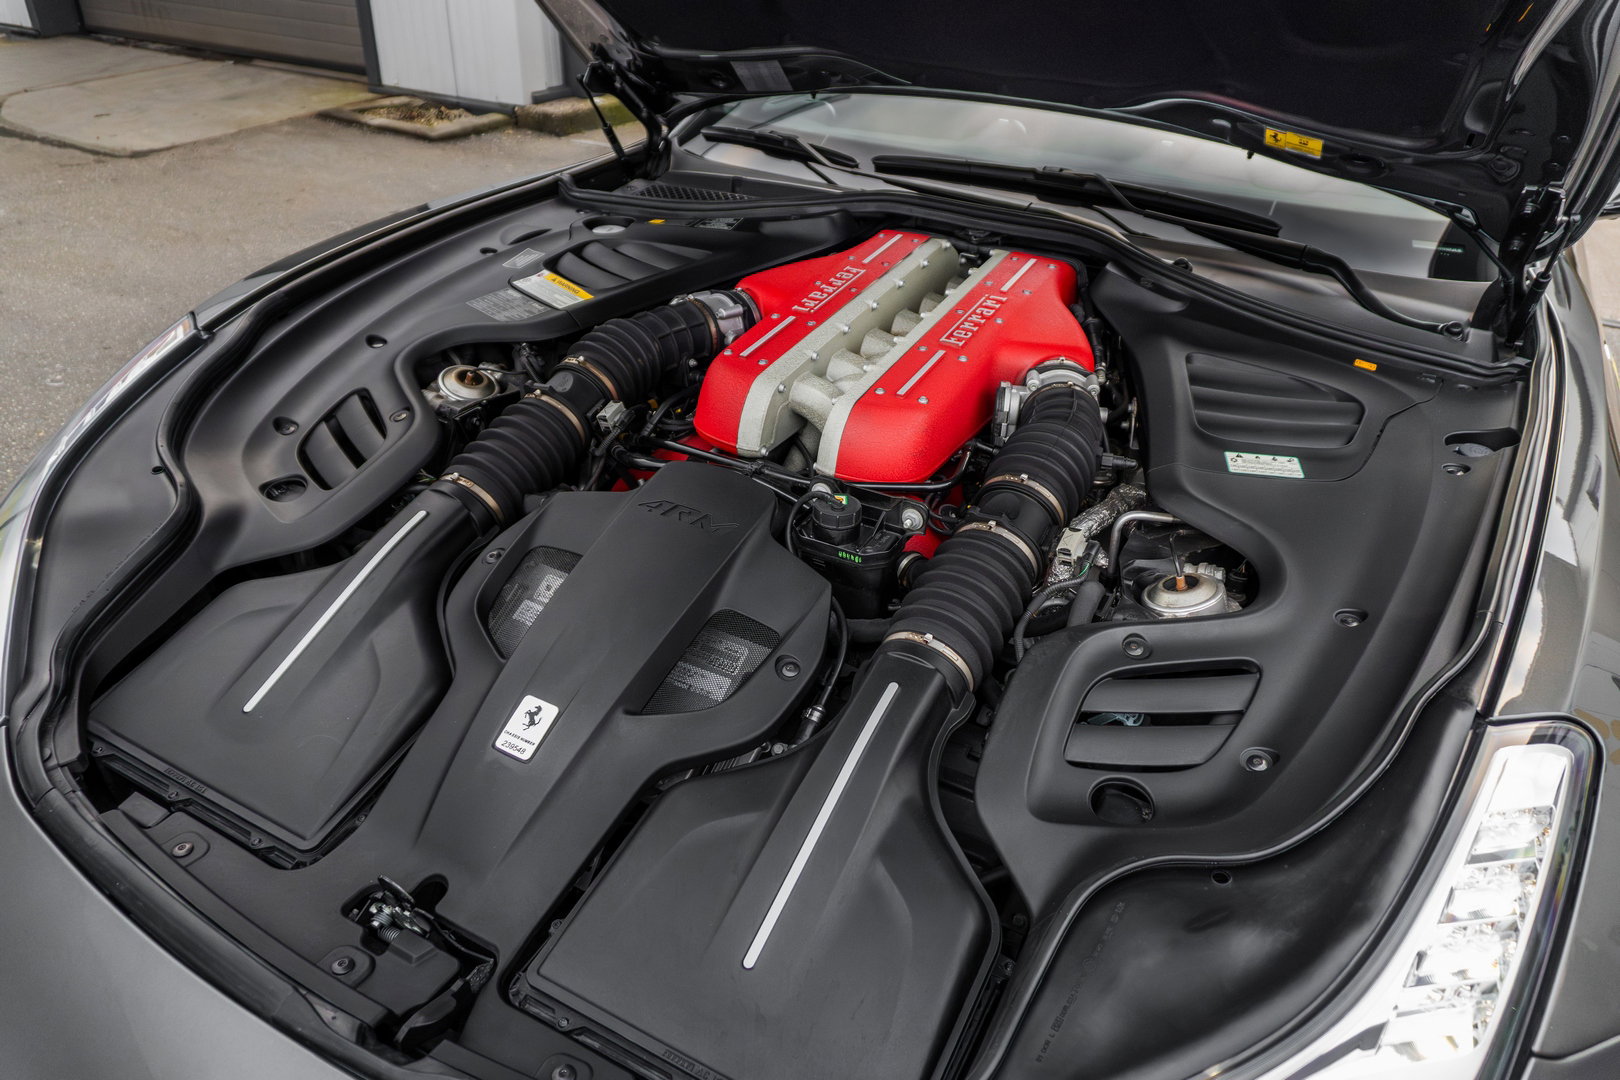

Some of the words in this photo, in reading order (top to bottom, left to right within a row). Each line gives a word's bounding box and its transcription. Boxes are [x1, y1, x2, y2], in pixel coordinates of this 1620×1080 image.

[557, 279, 580, 294] WARNING
[791, 266, 866, 313] Ferrari
[940, 294, 1008, 347] Ferrari
[503, 730, 520, 740] CHASSIS
[520, 737, 536, 746] NUMBER
[501, 740, 526, 755] 239548
